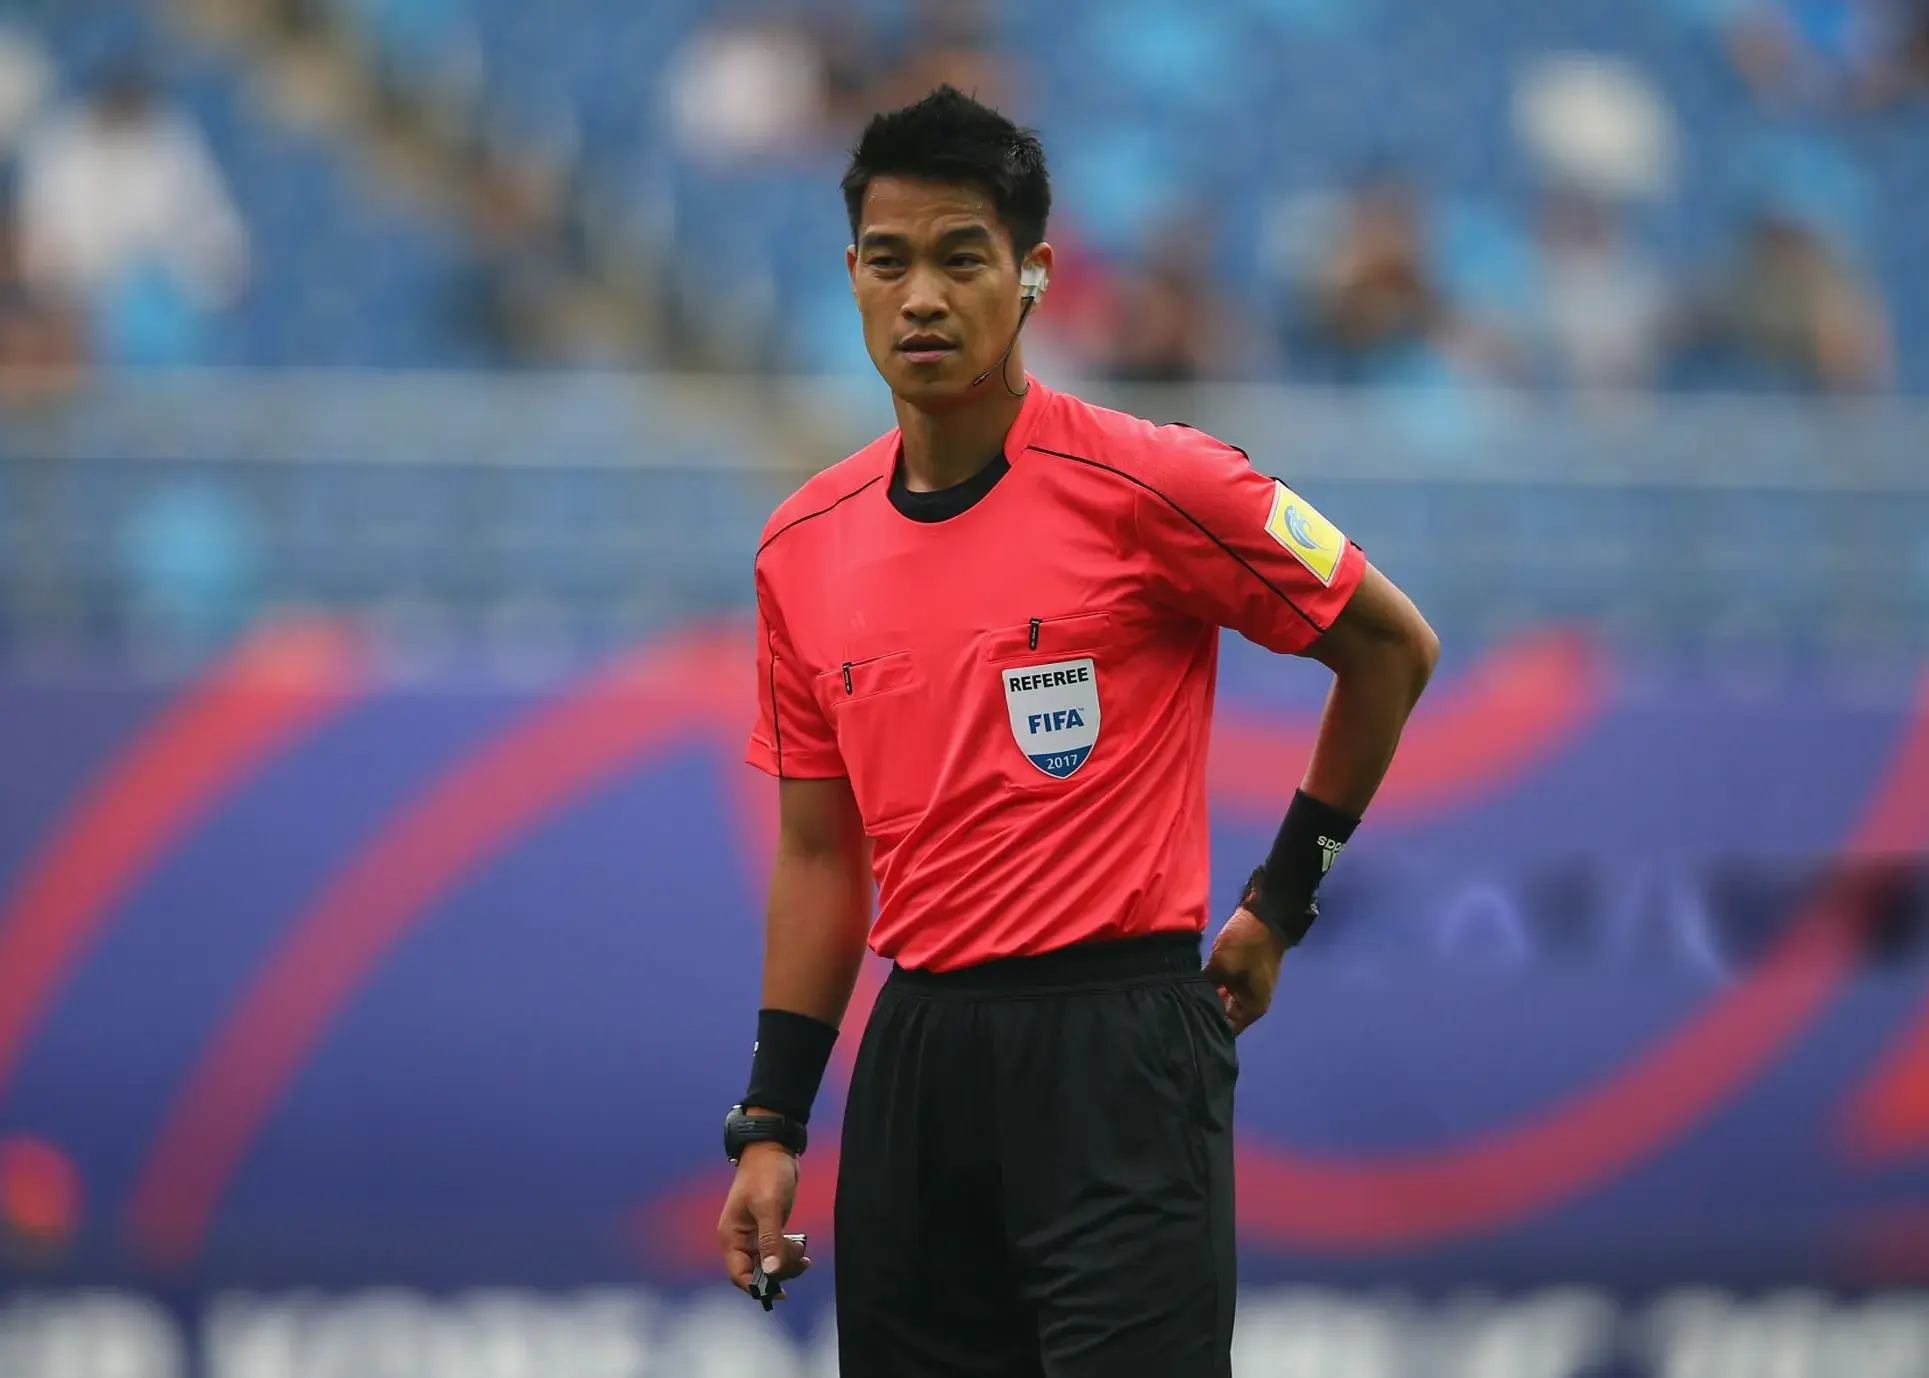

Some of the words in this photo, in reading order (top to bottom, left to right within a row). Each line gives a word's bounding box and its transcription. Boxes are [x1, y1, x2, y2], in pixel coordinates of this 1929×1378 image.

[1009, 667, 1089, 692] REFEREE
[1028, 708, 1085, 734] FIFA
[1046, 754, 1078, 770] 2017
